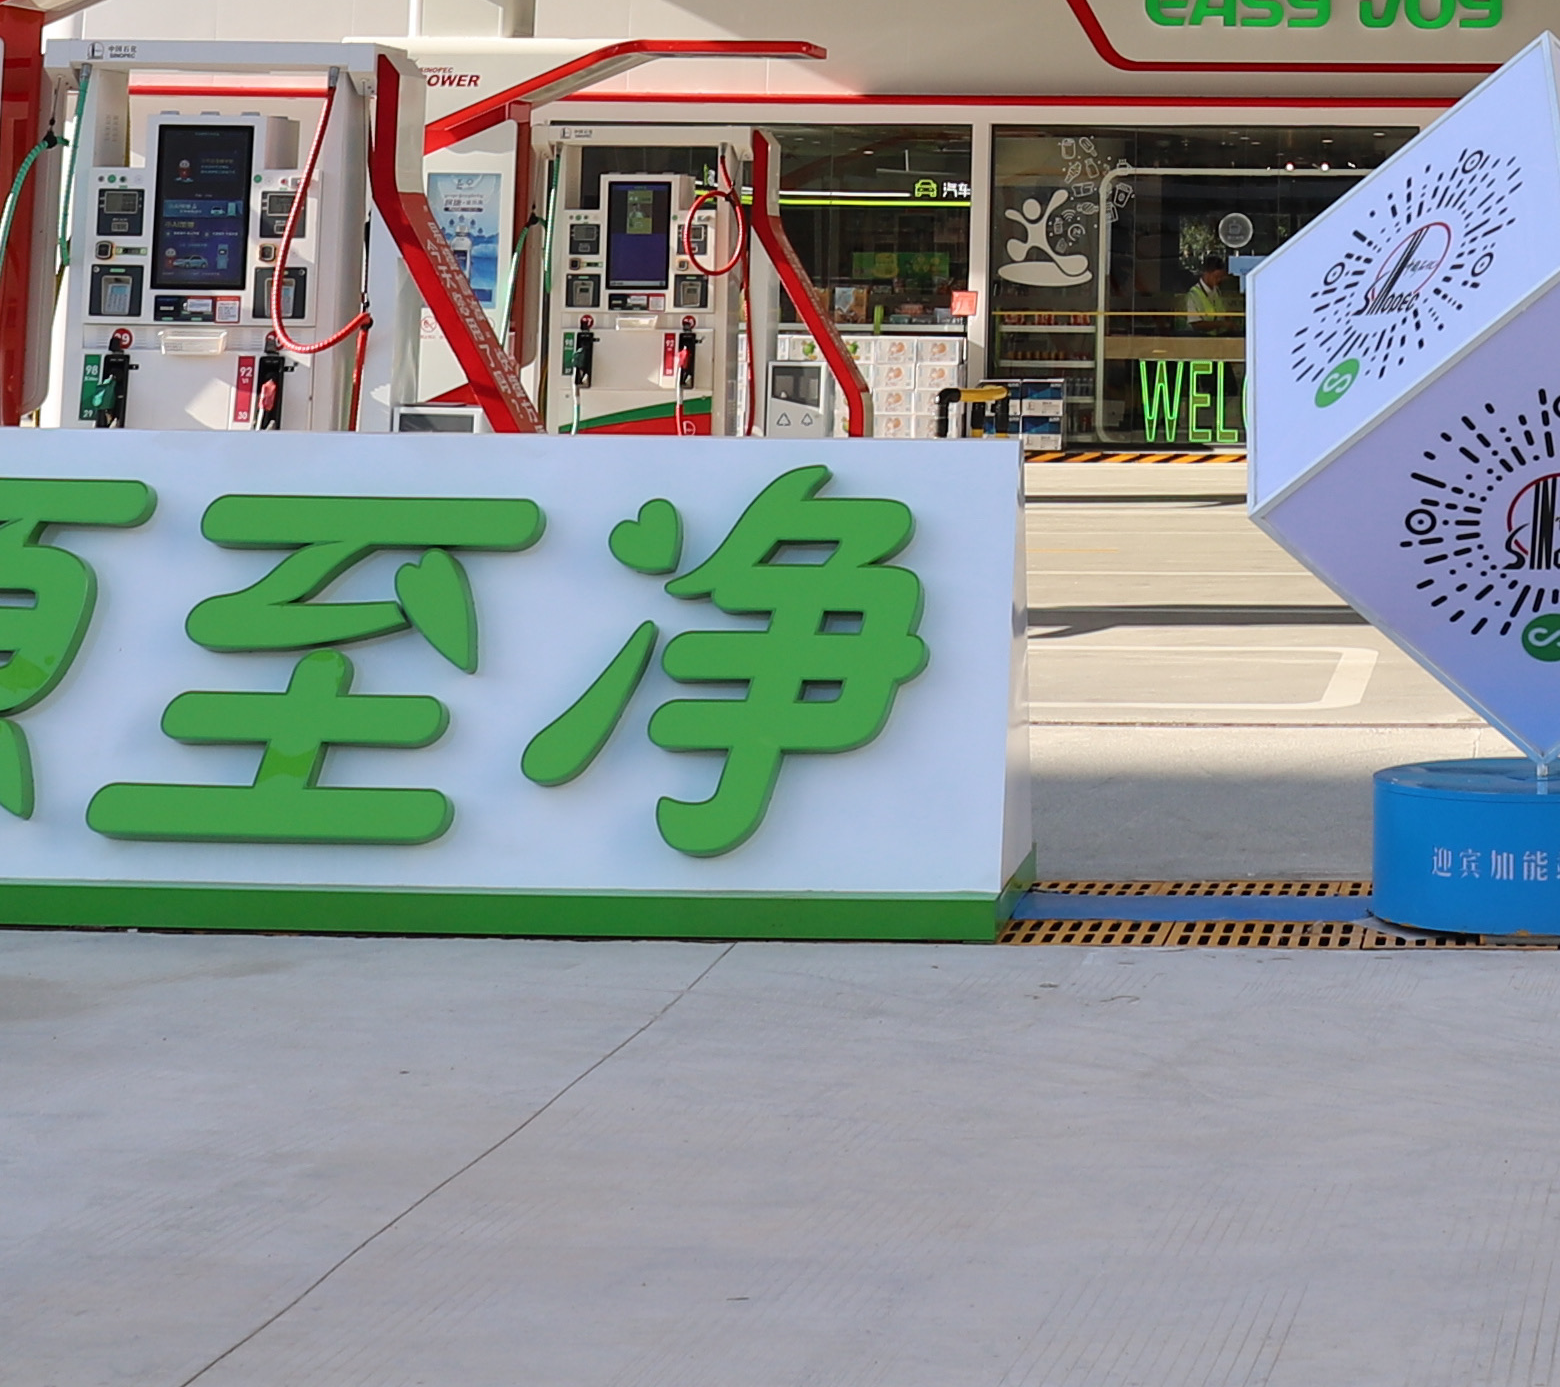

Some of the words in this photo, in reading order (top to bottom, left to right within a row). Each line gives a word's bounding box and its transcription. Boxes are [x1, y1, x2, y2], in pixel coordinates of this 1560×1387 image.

[426, 73, 481, 88] OWER
[942, 181, 971, 198] 汽车
[84, 364, 99, 376] 98
[239, 365, 253, 377] 92
[1139, 359, 1247, 444] WEL
